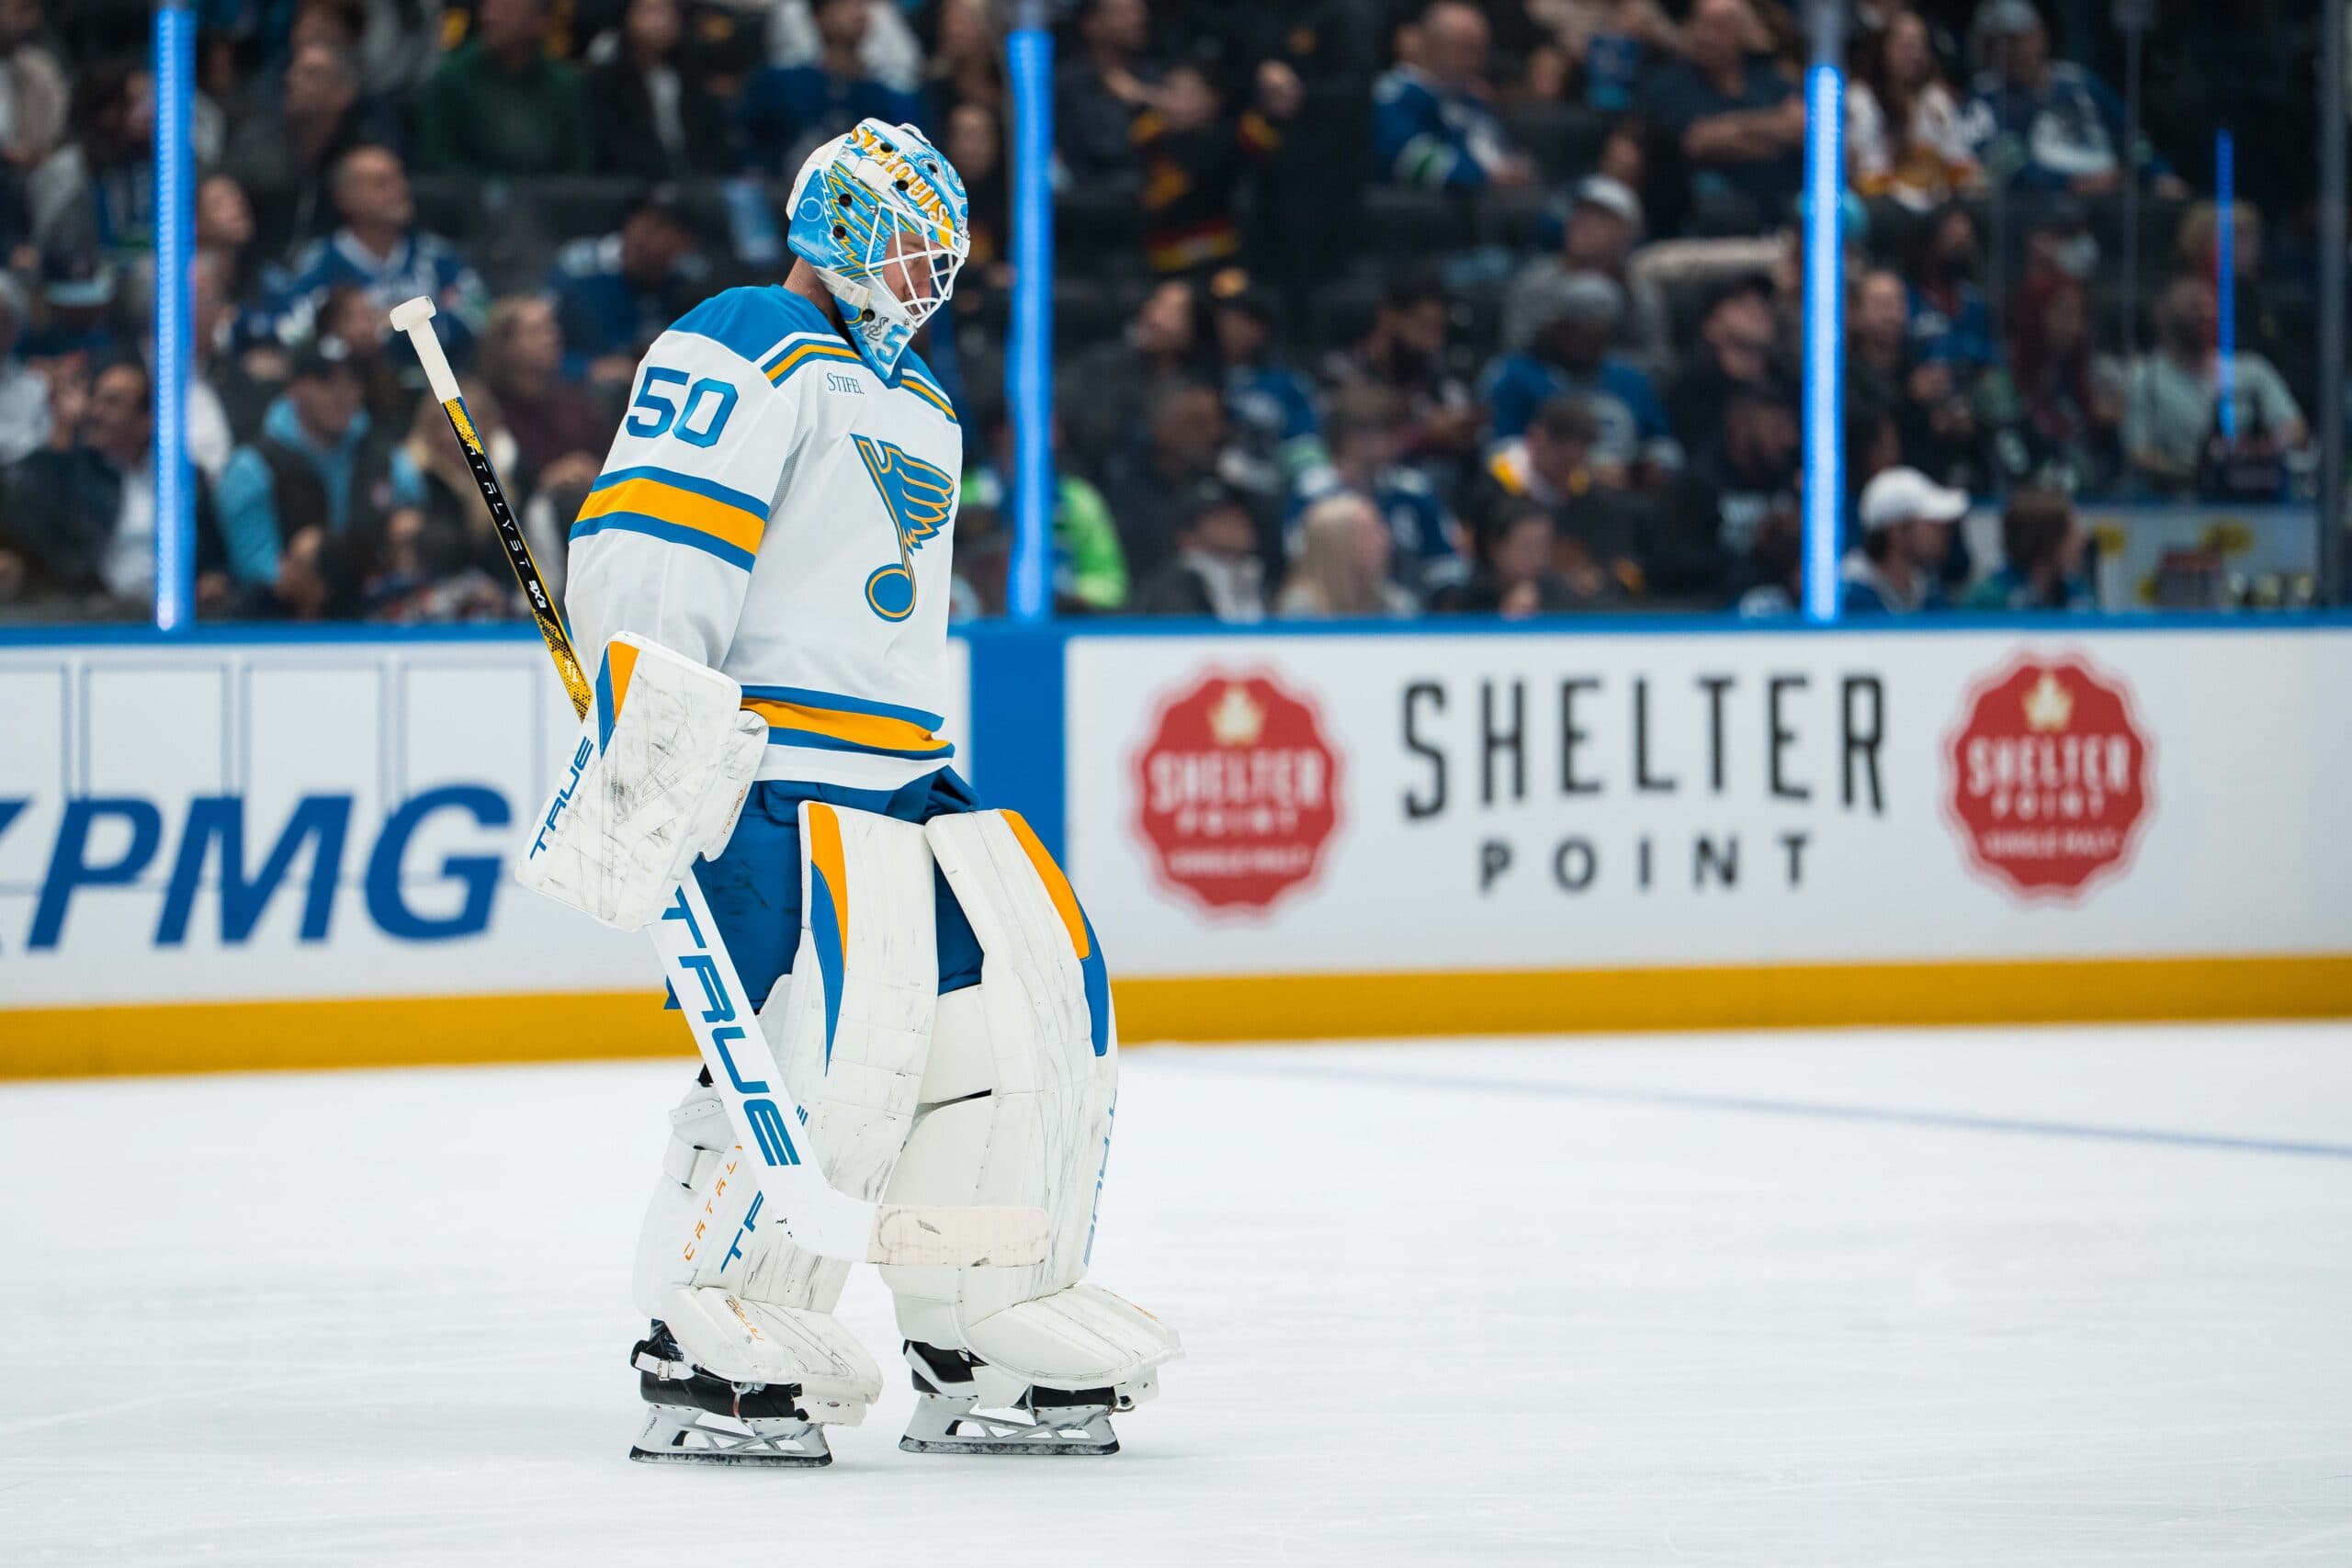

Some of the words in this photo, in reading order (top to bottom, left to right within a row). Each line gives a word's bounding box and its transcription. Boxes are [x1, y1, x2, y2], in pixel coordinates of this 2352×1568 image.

[624, 366, 740, 449] 50
[826, 372, 865, 395] STIFEL
[528, 736, 594, 860] TRUE
[1401, 673, 1885, 822] SHELTER
[0, 783, 514, 952] PMG
[1479, 833, 1808, 893] POINT
[661, 885, 802, 1167] TRUE
